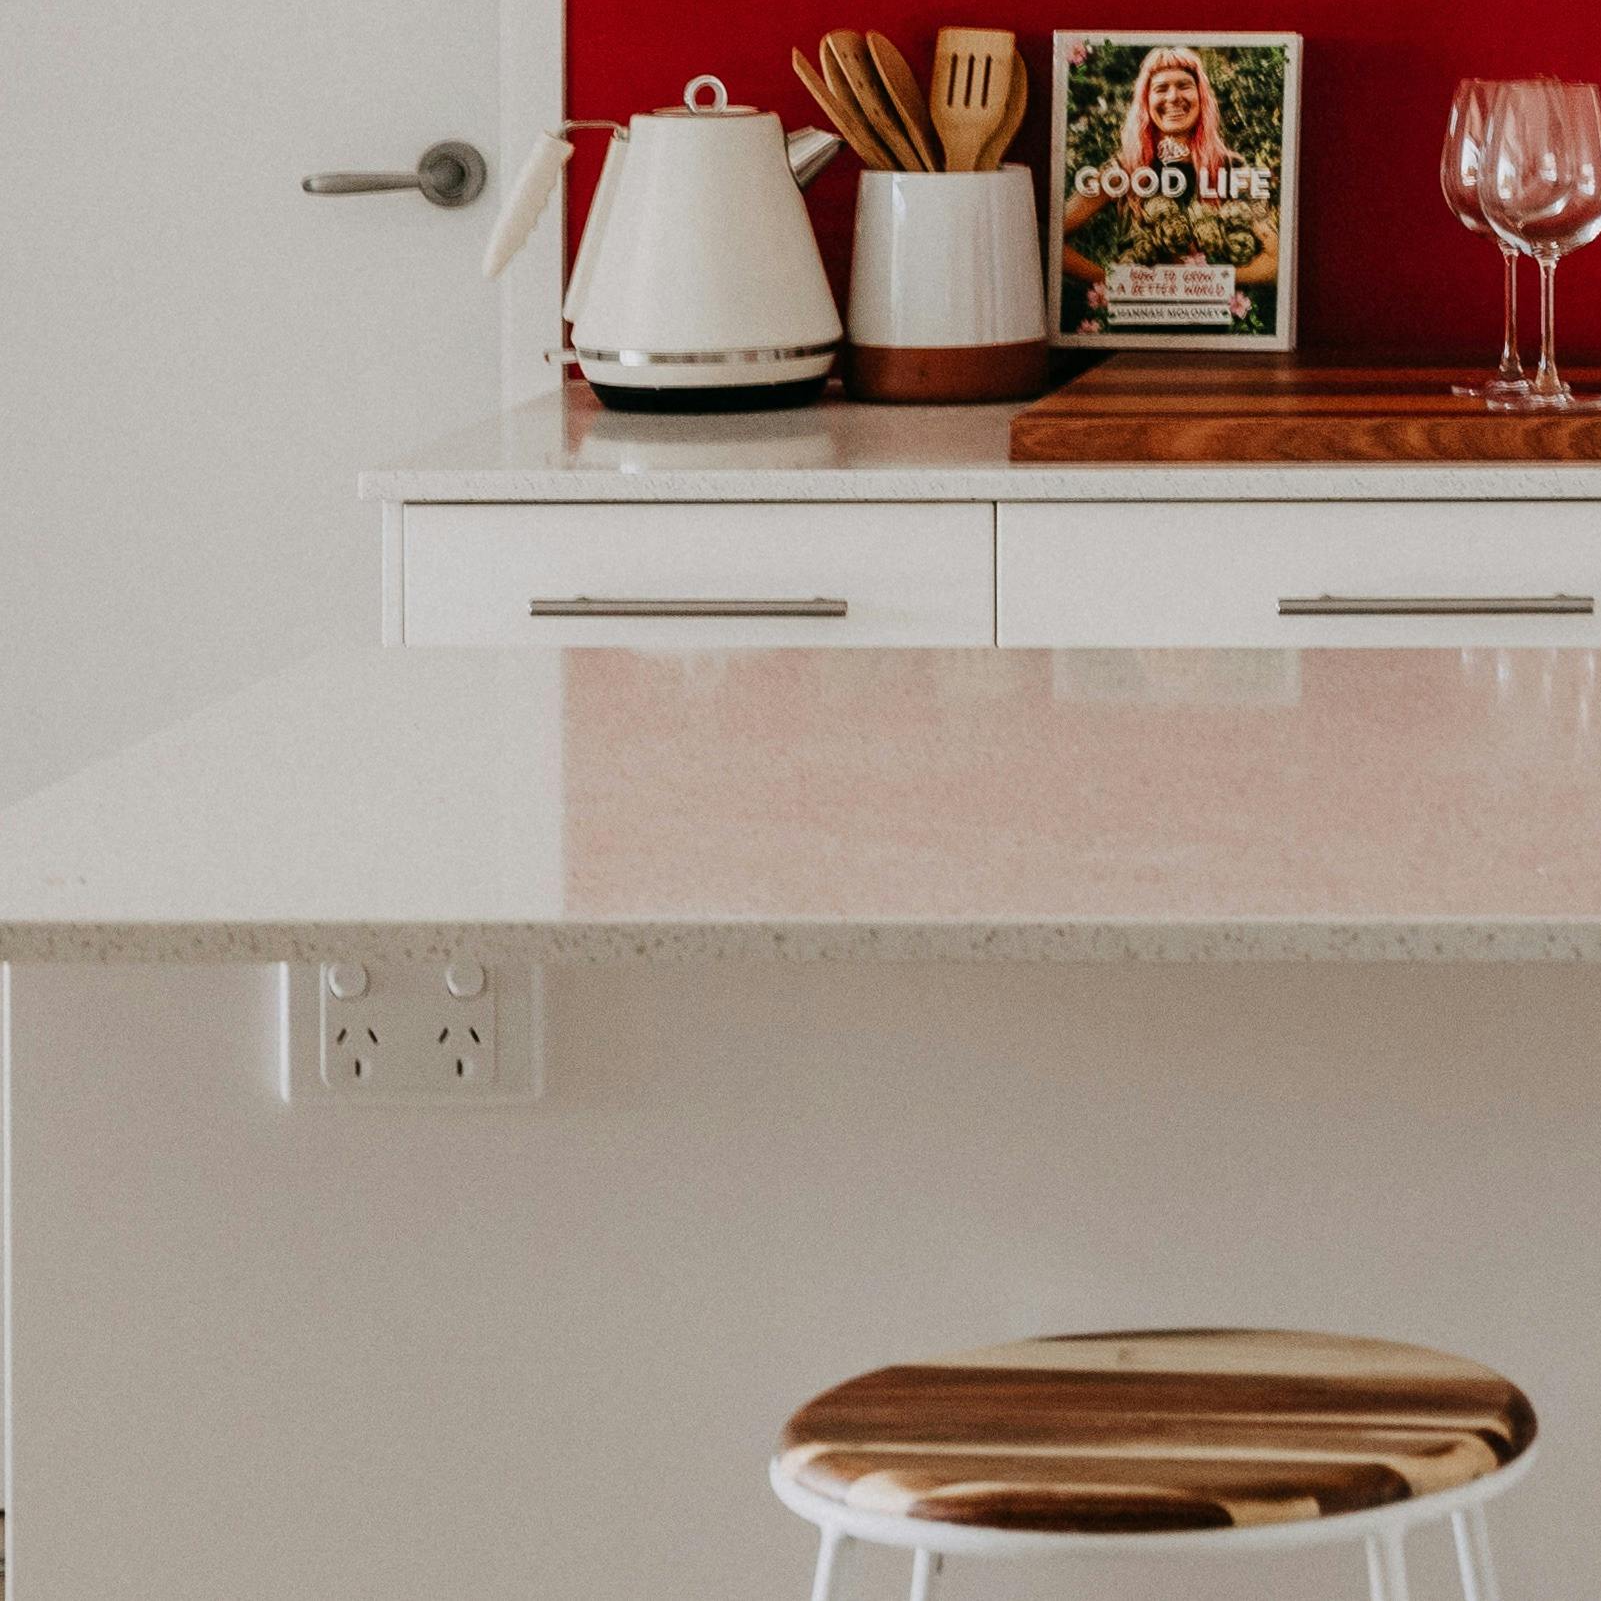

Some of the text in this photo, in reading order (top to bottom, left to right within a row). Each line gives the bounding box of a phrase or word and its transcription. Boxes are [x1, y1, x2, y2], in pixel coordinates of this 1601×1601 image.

[1074, 165, 1272, 199] GOOD LIFE
[1118, 308, 1221, 319] HANNAH MOLONEY
